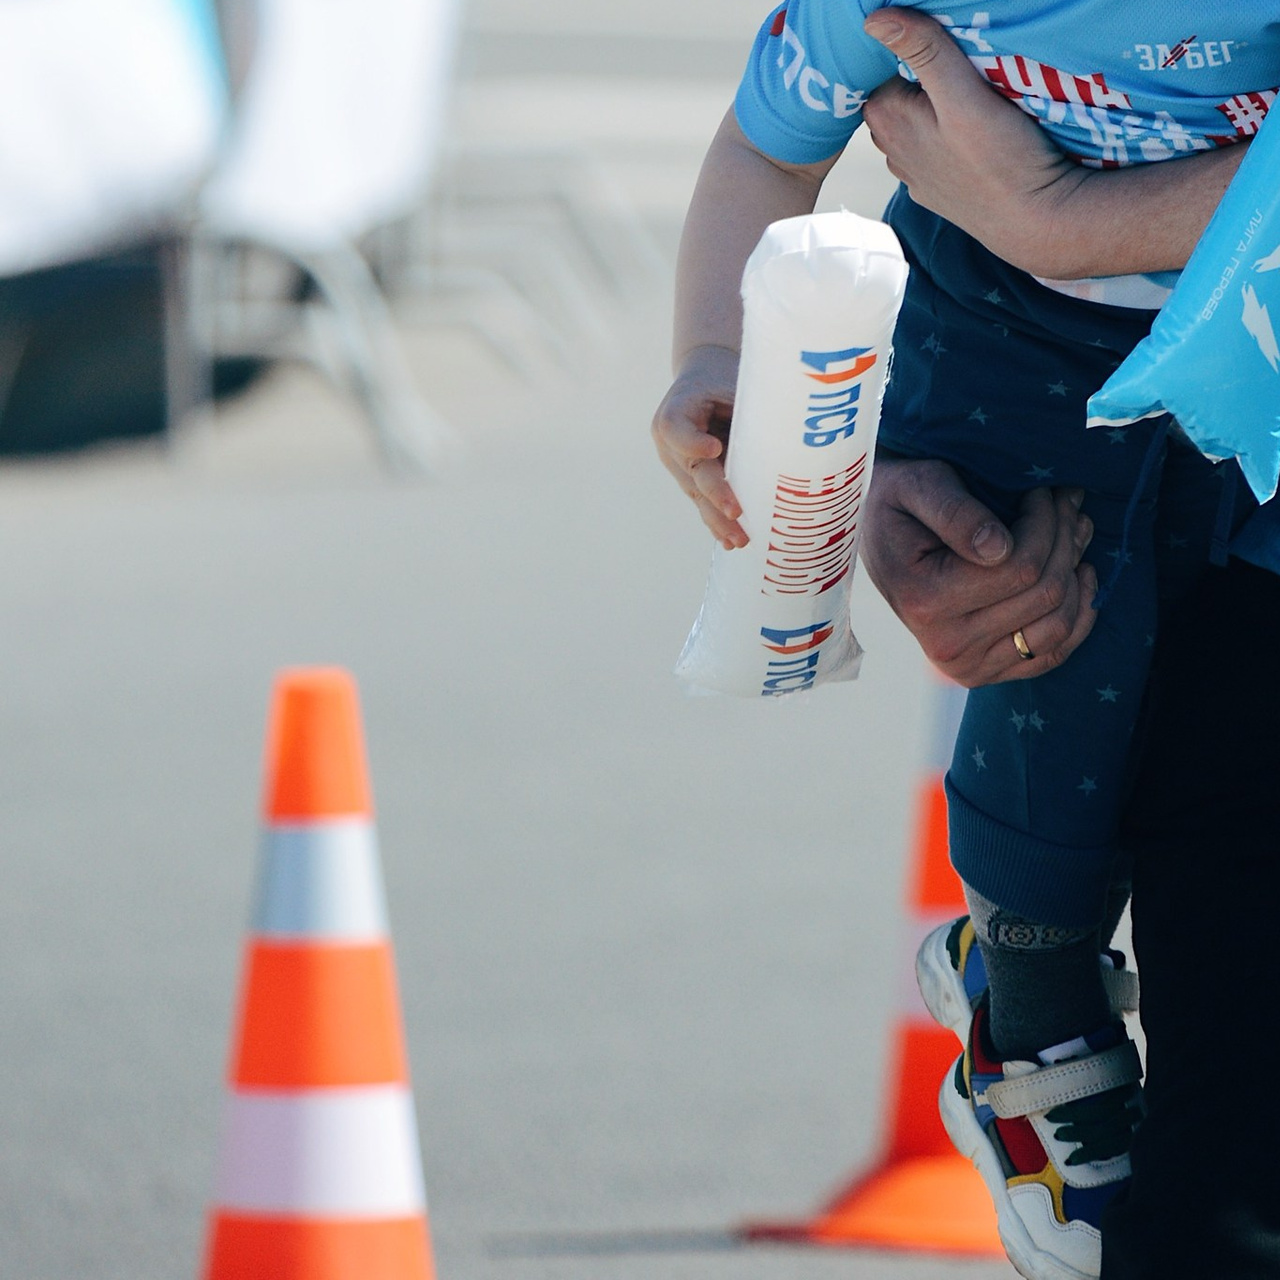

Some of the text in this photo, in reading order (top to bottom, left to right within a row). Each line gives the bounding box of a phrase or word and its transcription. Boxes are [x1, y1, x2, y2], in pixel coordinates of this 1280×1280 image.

[1201, 207, 1263, 321] ЛИГА ГЕРОЕВ
[803, 382, 861, 448] ПСБ
